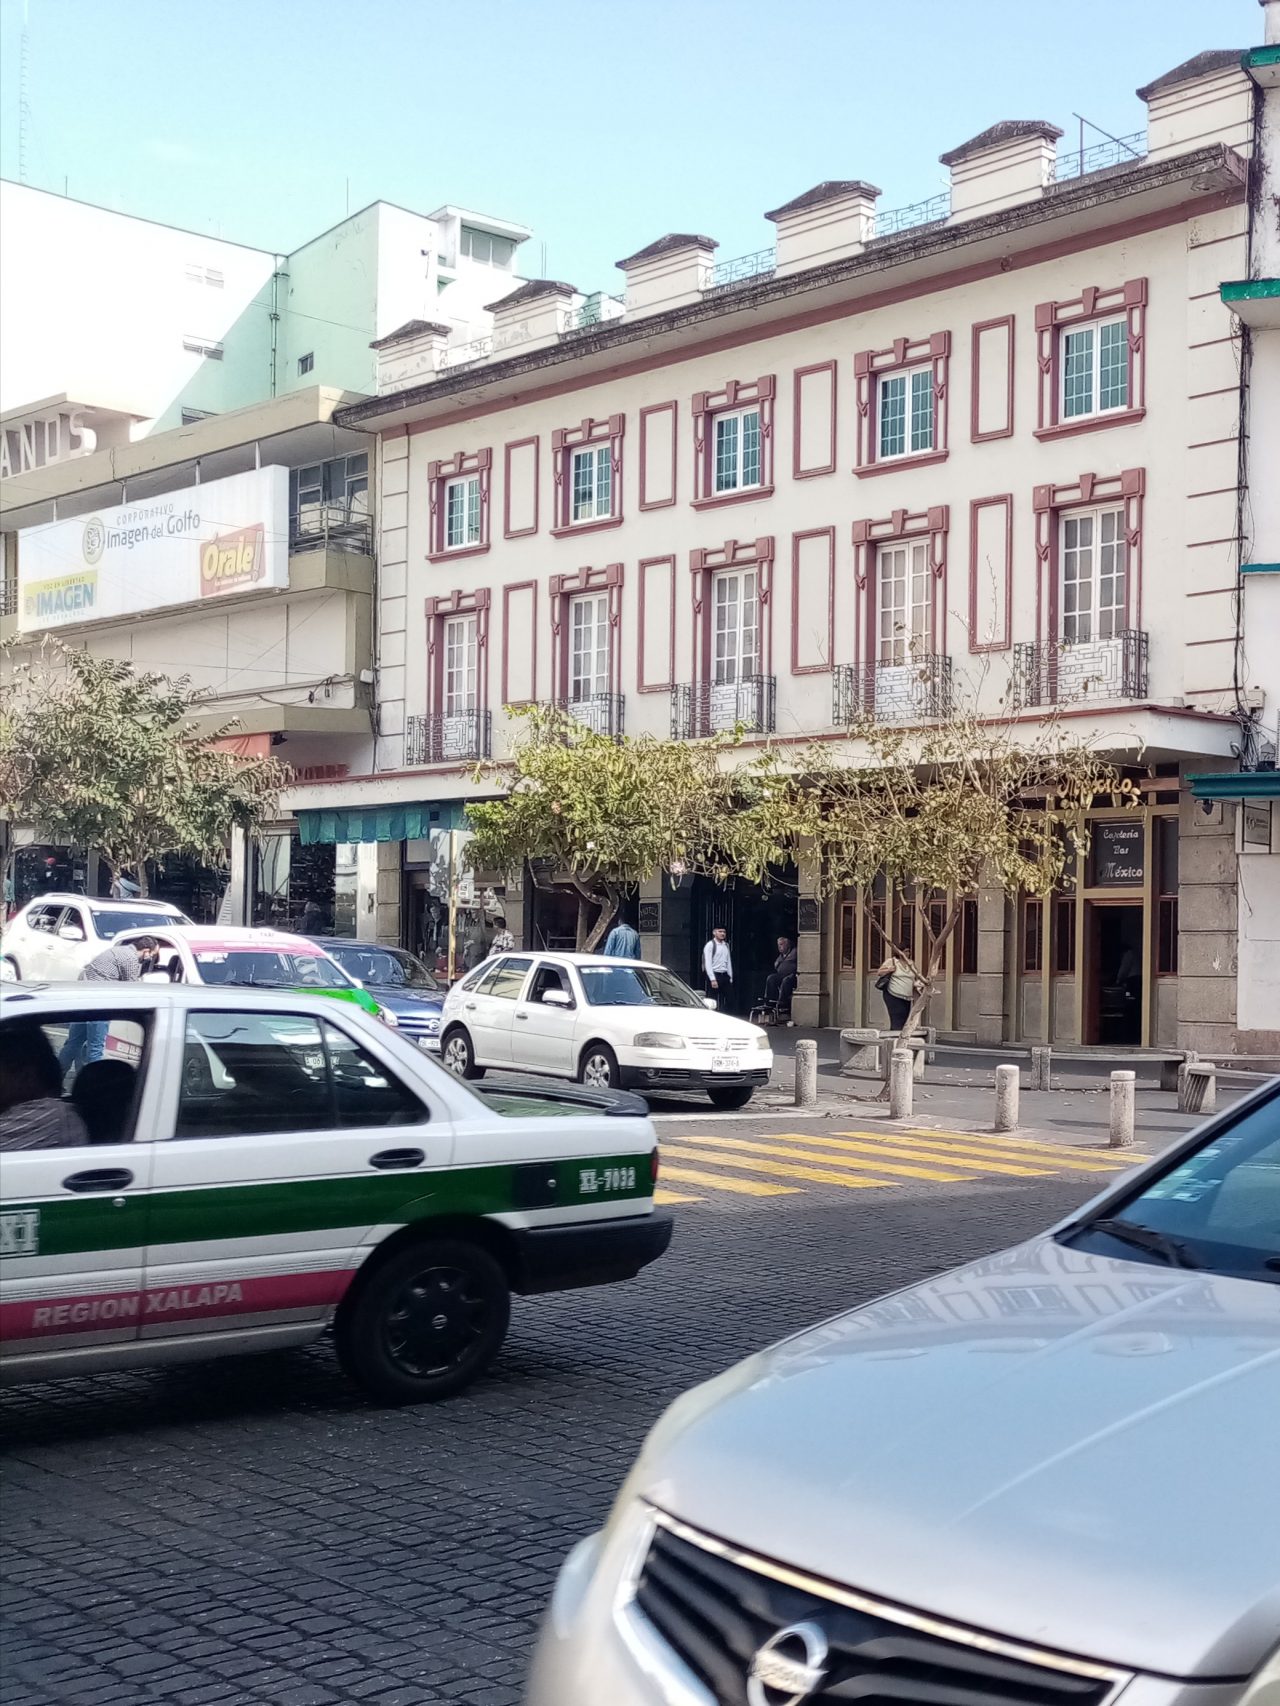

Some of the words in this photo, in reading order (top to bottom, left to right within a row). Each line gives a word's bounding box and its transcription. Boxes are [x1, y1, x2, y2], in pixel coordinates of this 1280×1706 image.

[106, 526, 149, 549] Imagen
[151, 523, 164, 539] del
[166, 509, 200, 535] Golfo
[116, 503, 174, 526] CORPORATIVO
[36, 582, 94, 617] IMAGEN
[1103, 862, 1143, 878] México
[32, 1296, 140, 1329] REGION
[144, 1283, 243, 1314] XALAPA
